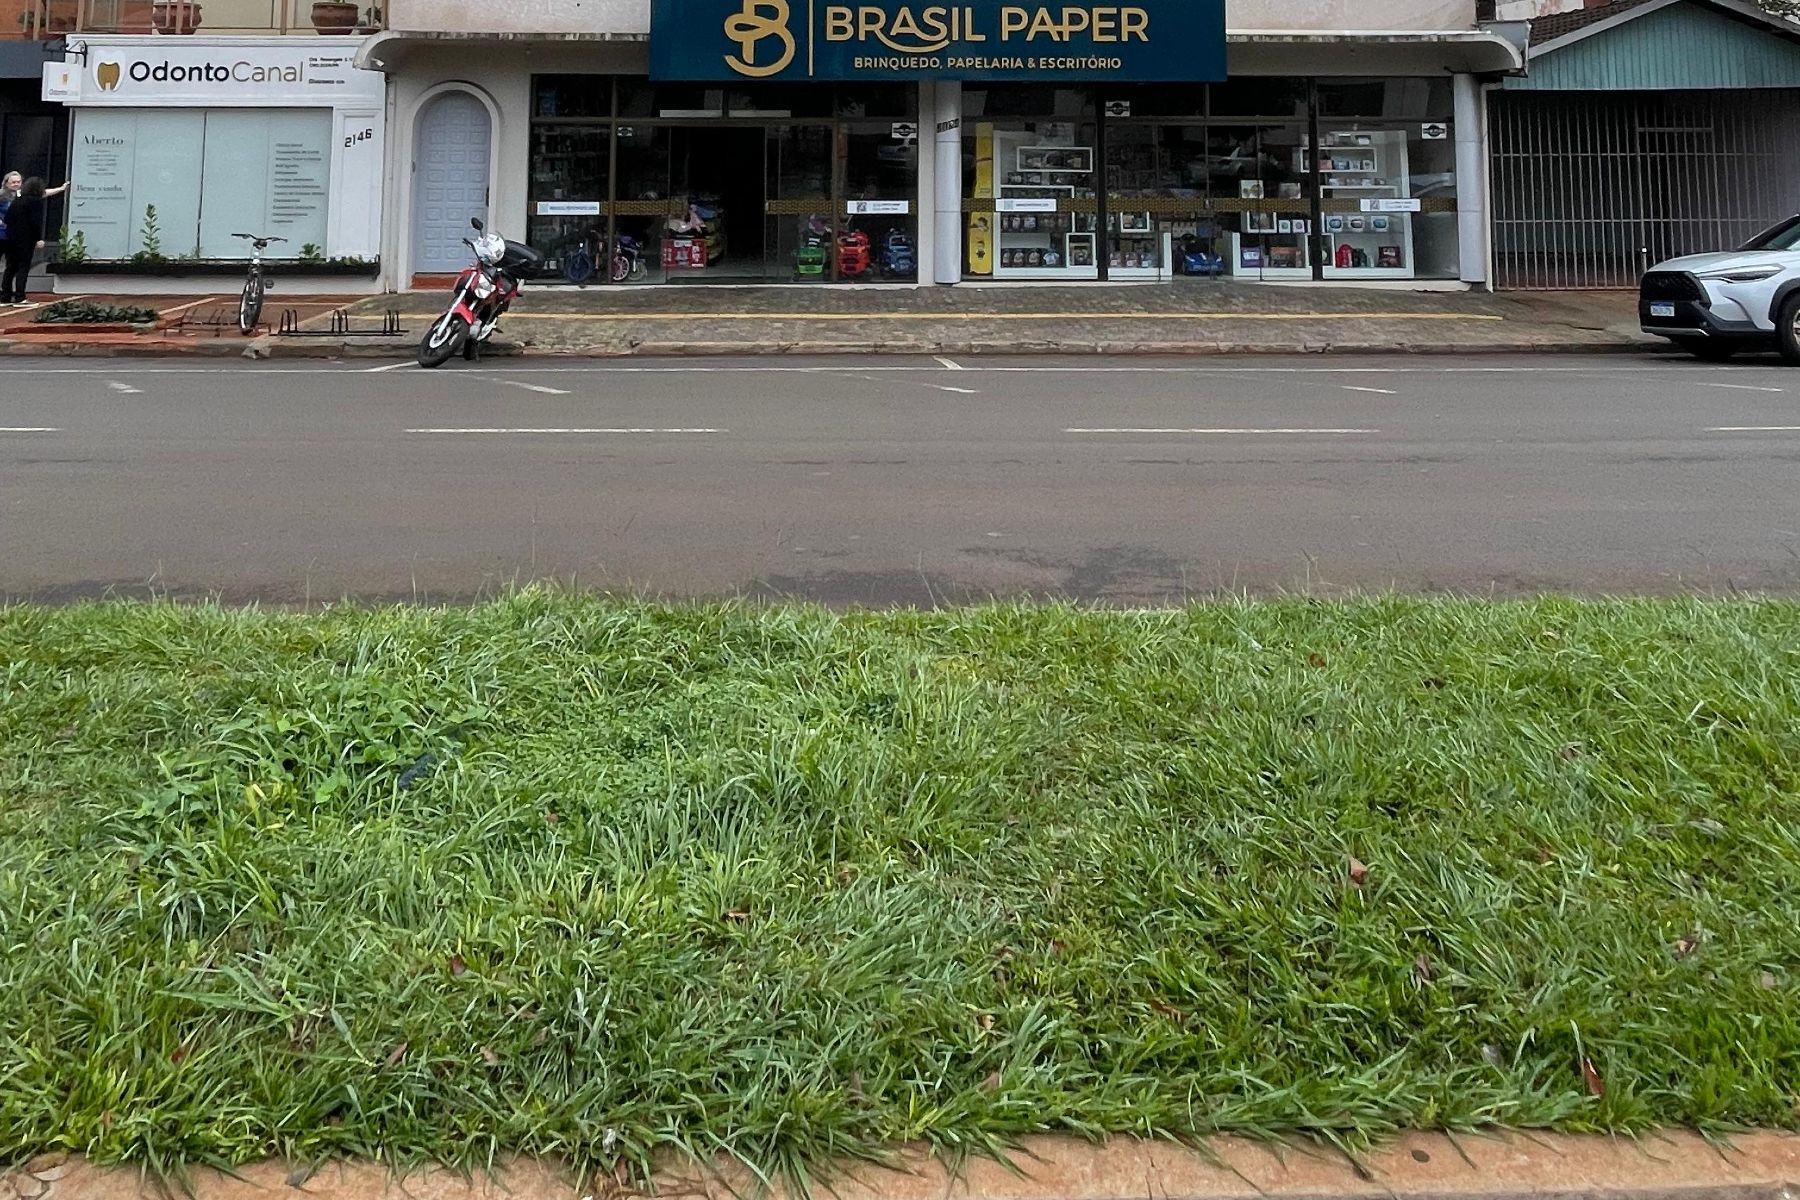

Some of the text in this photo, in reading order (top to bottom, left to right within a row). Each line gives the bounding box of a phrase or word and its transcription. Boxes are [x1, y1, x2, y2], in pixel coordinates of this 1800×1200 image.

[826, 6, 1149, 53] BRASIL PAPER
[129, 60, 304, 82] OdontoCanal
[854, 54, 1122, 70] BRINQUEDO, PAPELARIA & ESCRITÓRIO
[82, 134, 124, 146] Aberto
[344, 128, 373, 148] 2146
